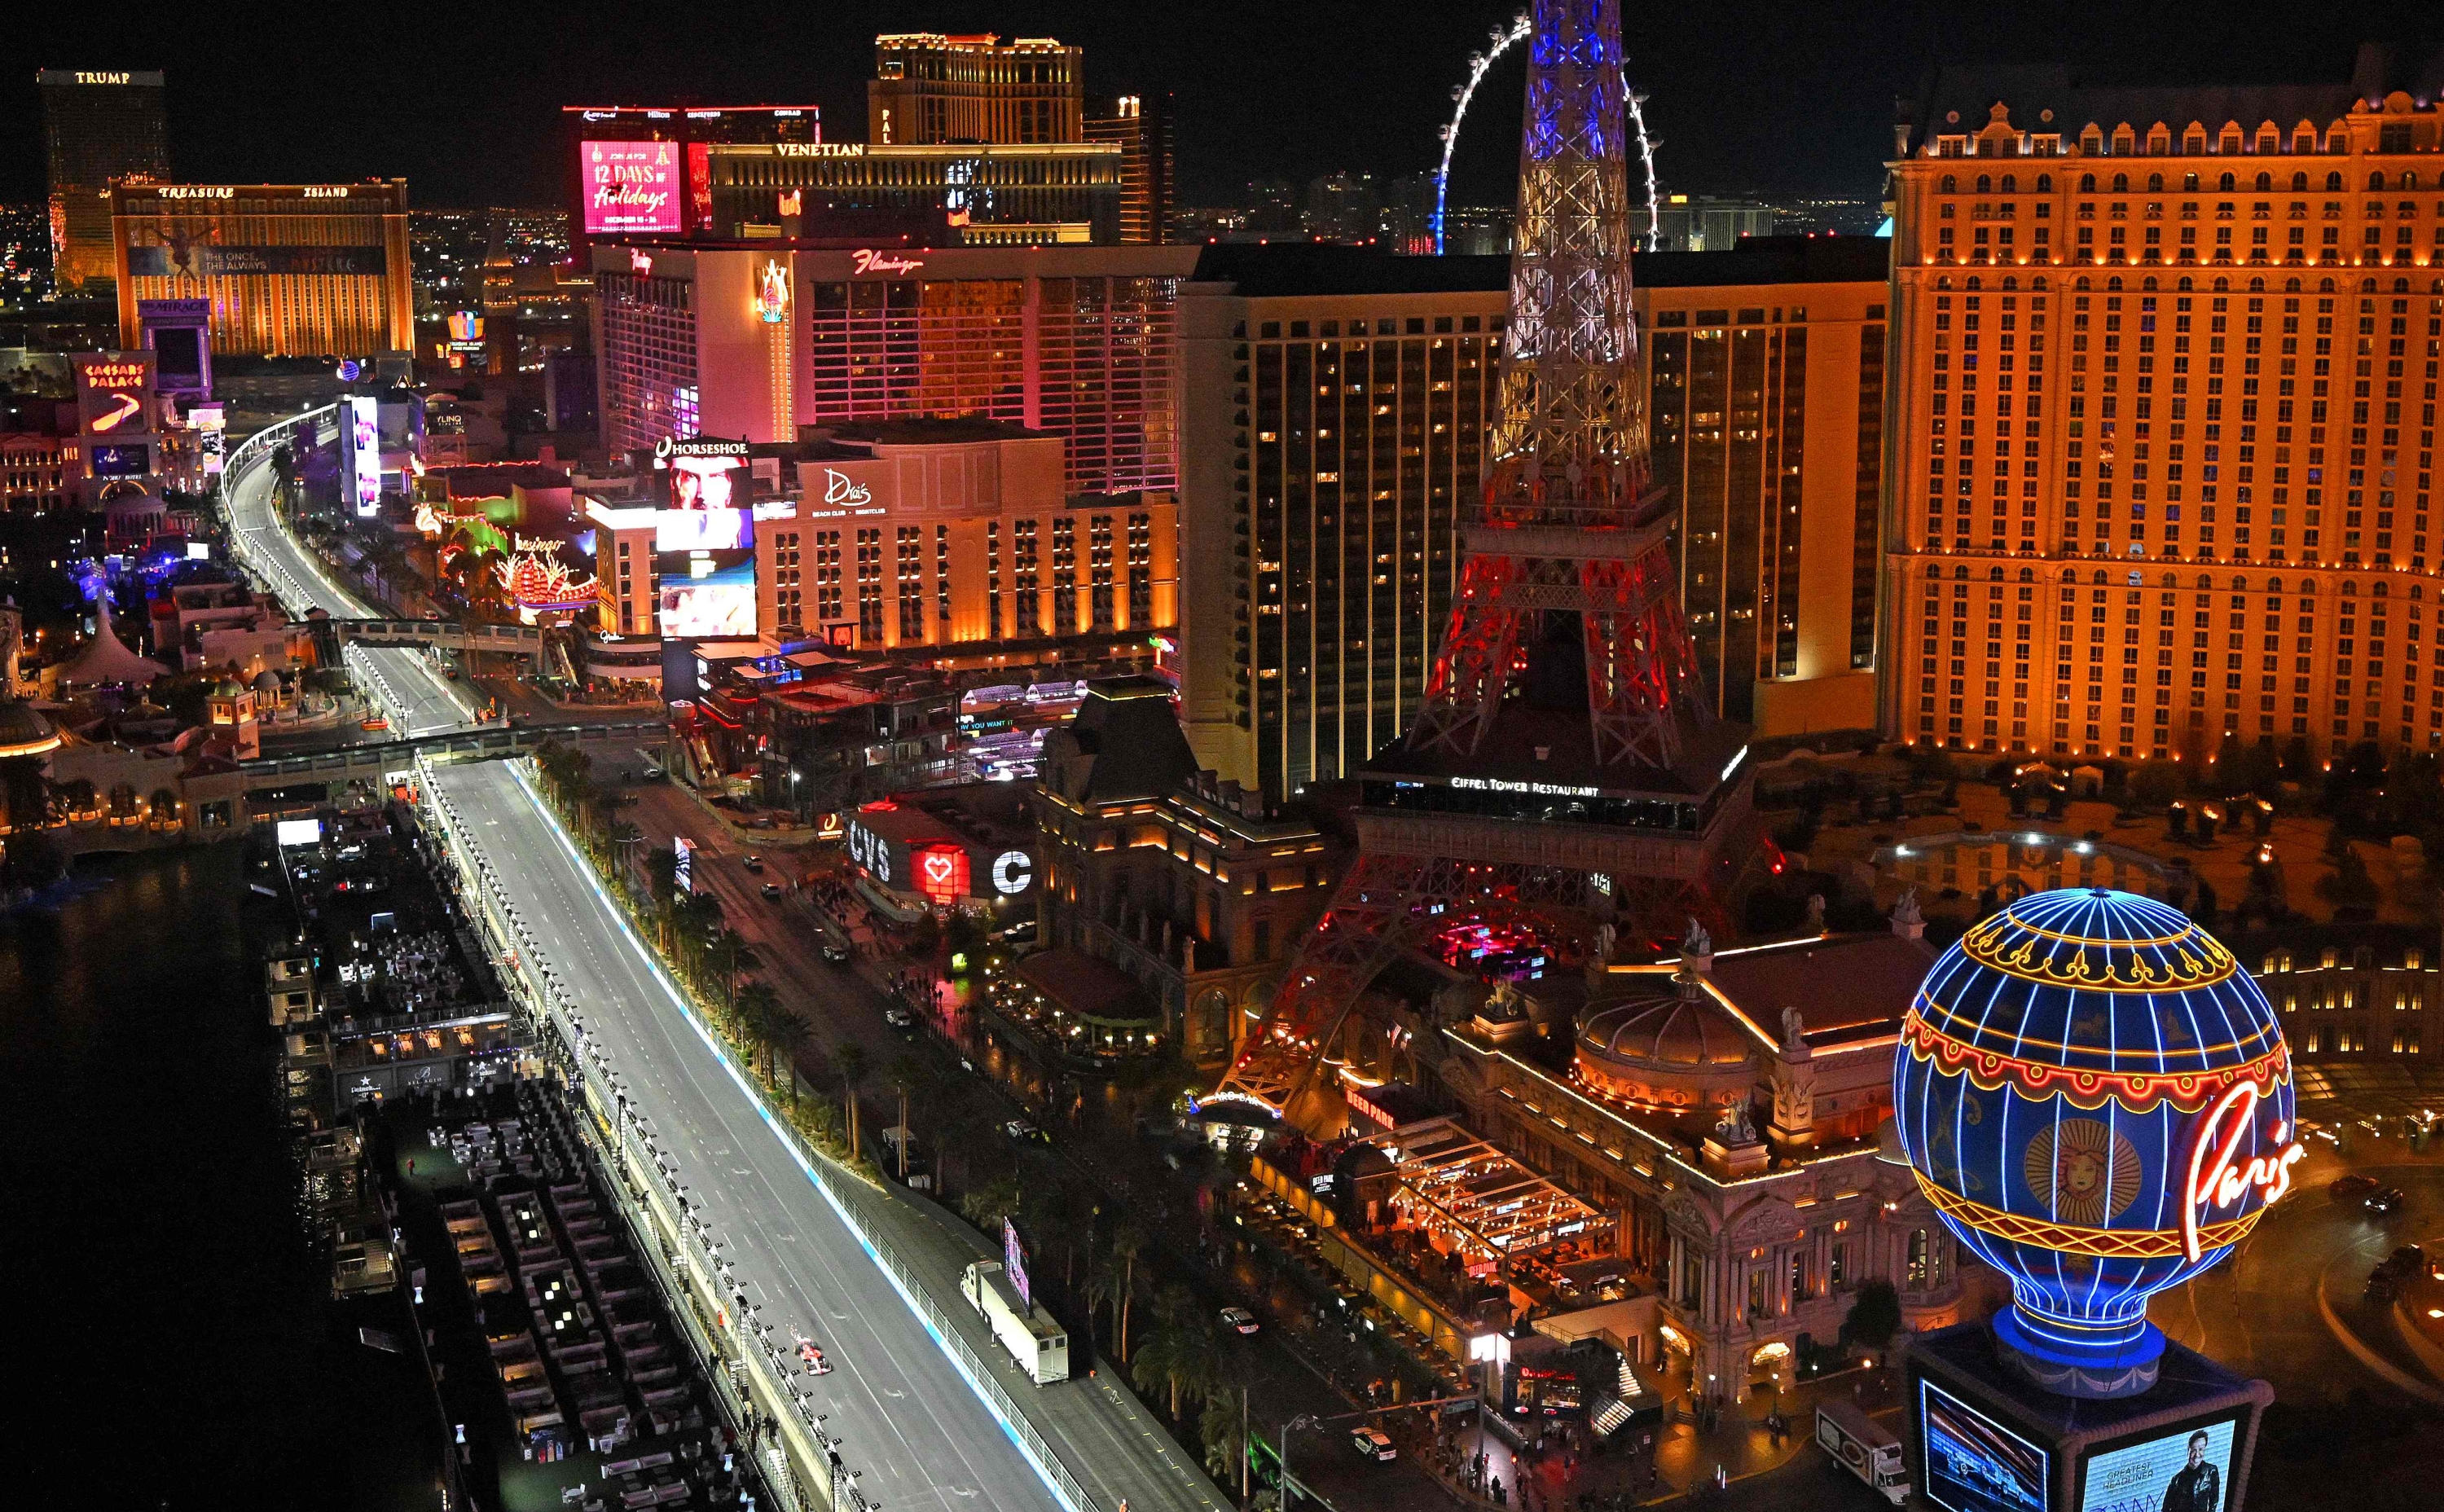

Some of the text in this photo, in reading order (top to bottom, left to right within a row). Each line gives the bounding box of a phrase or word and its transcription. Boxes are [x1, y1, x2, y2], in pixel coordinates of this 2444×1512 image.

[75, 72, 130, 84] TRUMP
[648, 111, 670, 119] Hilton
[776, 143, 864, 156] VENETIAN
[594, 165, 609, 183] 12
[614, 165, 654, 183] DAYS
[158, 187, 349, 200] TREASURE ISLAND
[593, 183, 669, 213] Holidays
[205, 253, 224, 262] THE
[852, 248, 924, 276] Flamingo
[205, 262, 267, 270] THE ALWAYS
[154, 301, 208, 312] MIRAGE
[85, 364, 144, 376] CAESARS
[89, 375, 143, 388] PALACE
[671, 442, 749, 455] HORSESHOE
[824, 467, 872, 507] Drai's
[855, 508, 886, 516] NIGHTCLUB
[987, 720, 1006, 728] WANT
[1451, 776, 1599, 797] EIFFEL TOWER RESTAURANT
[850, 820, 890, 882] CVS
[992, 850, 1031, 894] C
[407, 1077, 442, 1086] BELAGIO
[1347, 1089, 1394, 1131] BEER PARK
[2182, 1079, 2305, 1264] Paris
[1469, 1262, 1497, 1277] BEER PARK
[2107, 1461, 2152, 1480] GREATEST
[2102, 1470, 2154, 1491] HEADLINER
